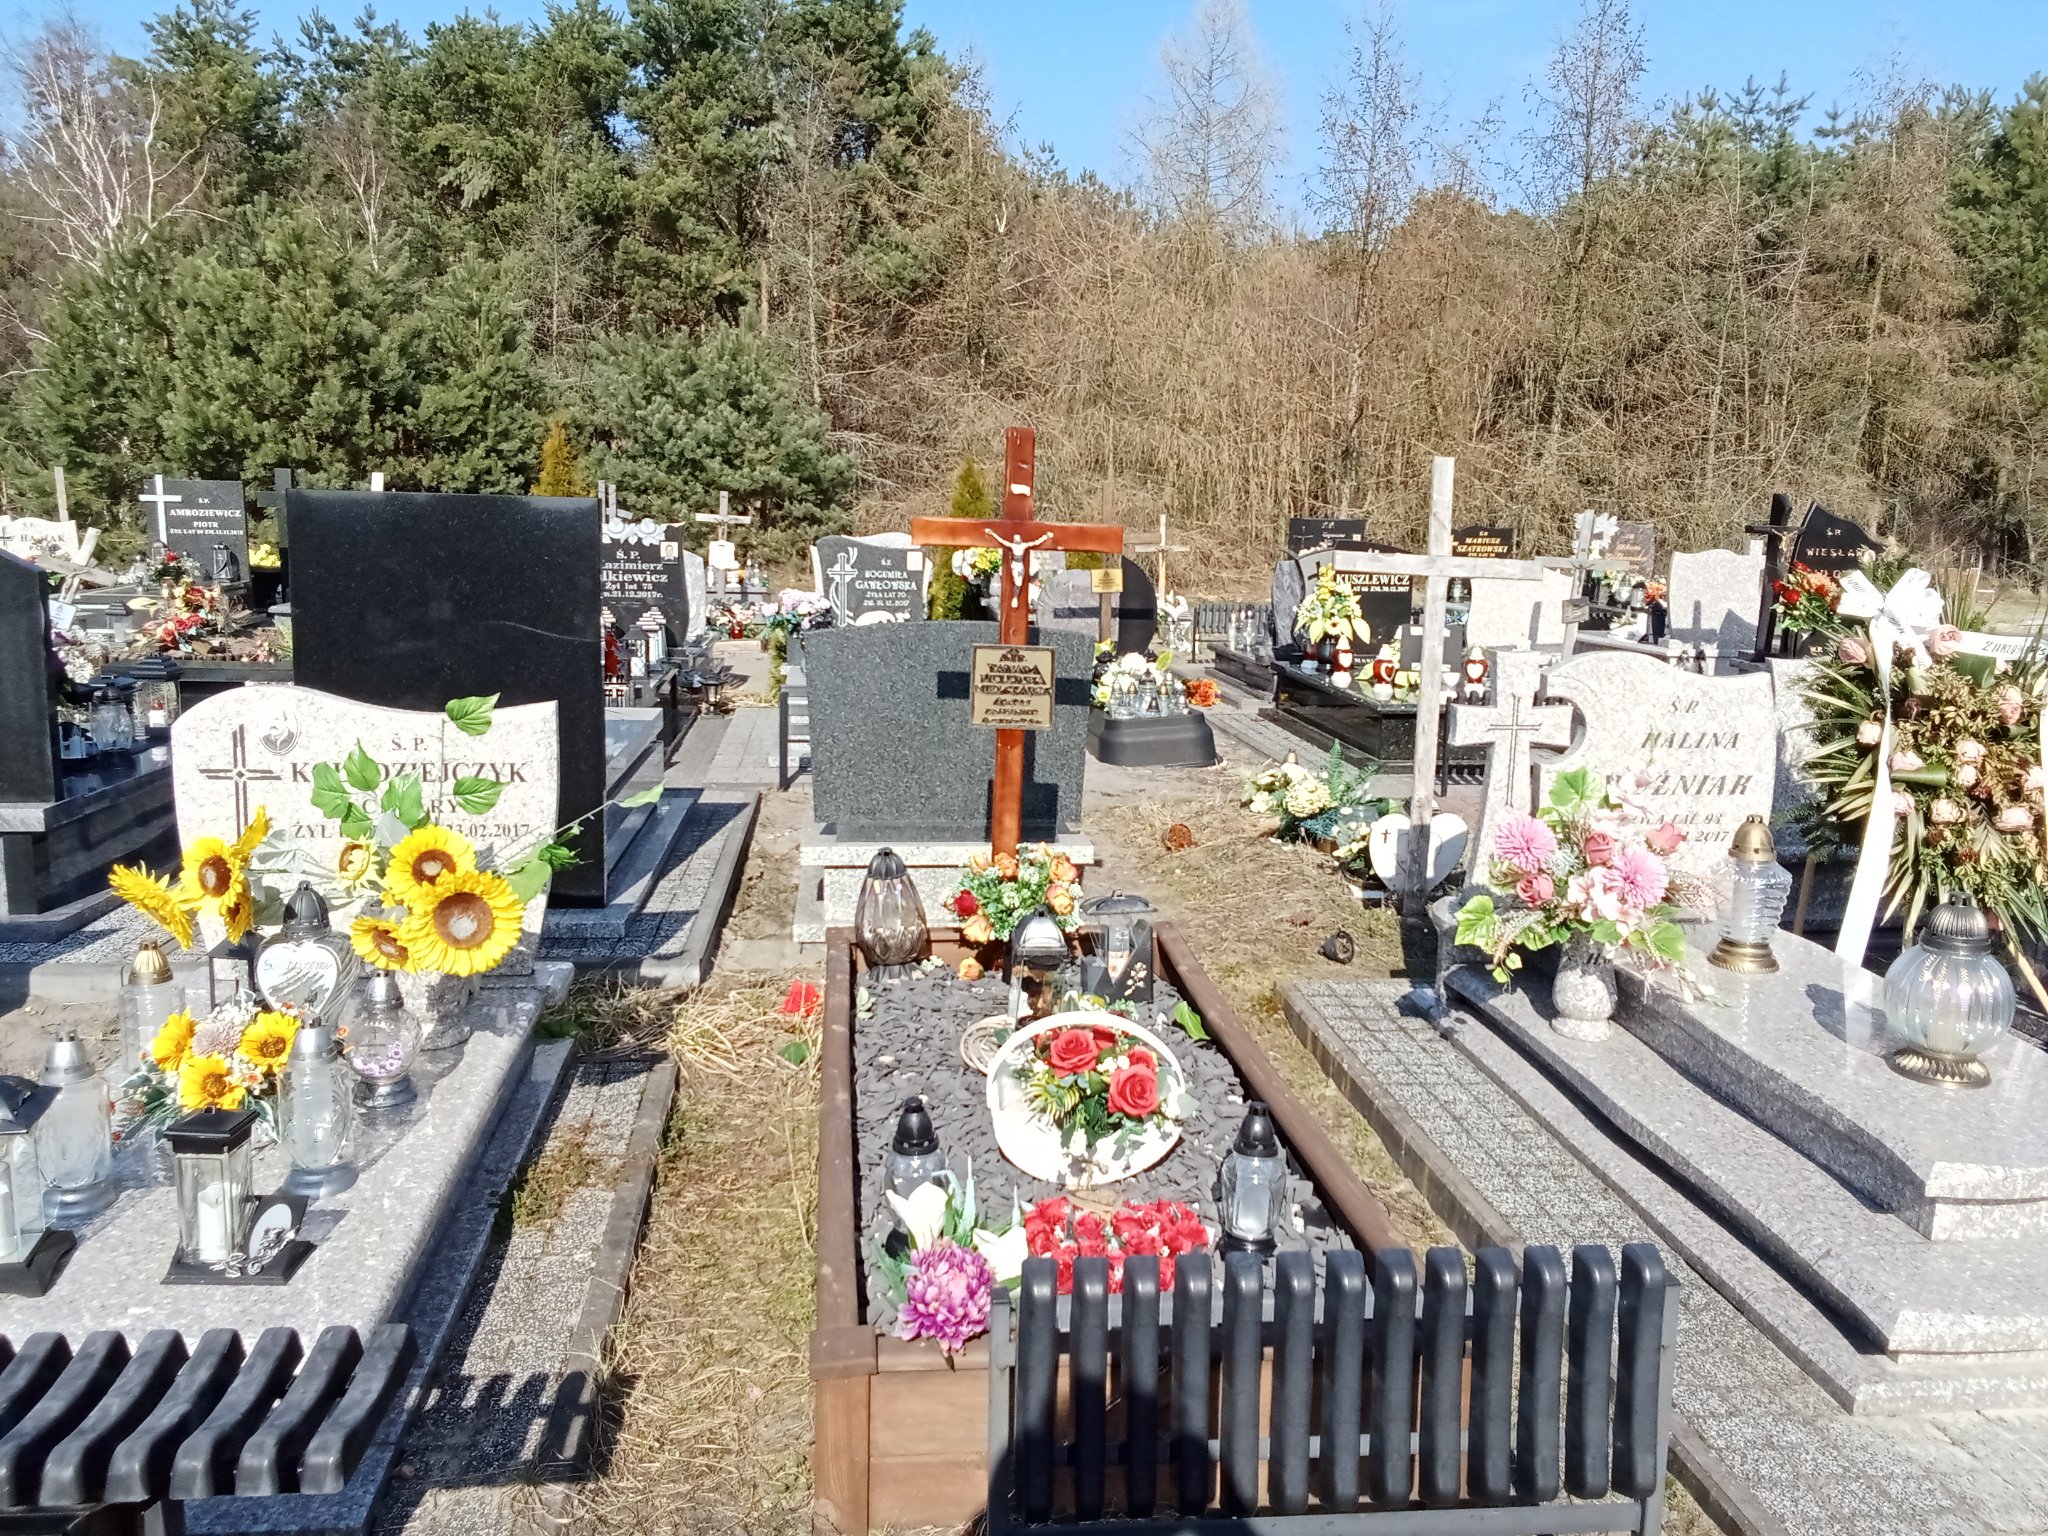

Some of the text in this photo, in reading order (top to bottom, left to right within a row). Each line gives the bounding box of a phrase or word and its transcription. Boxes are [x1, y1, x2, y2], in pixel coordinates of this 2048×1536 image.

[169, 508, 242, 518] AMROZIEWICZ
[601, 560, 664, 570] azimierz
[1641, 732, 1740, 750] HALINA
